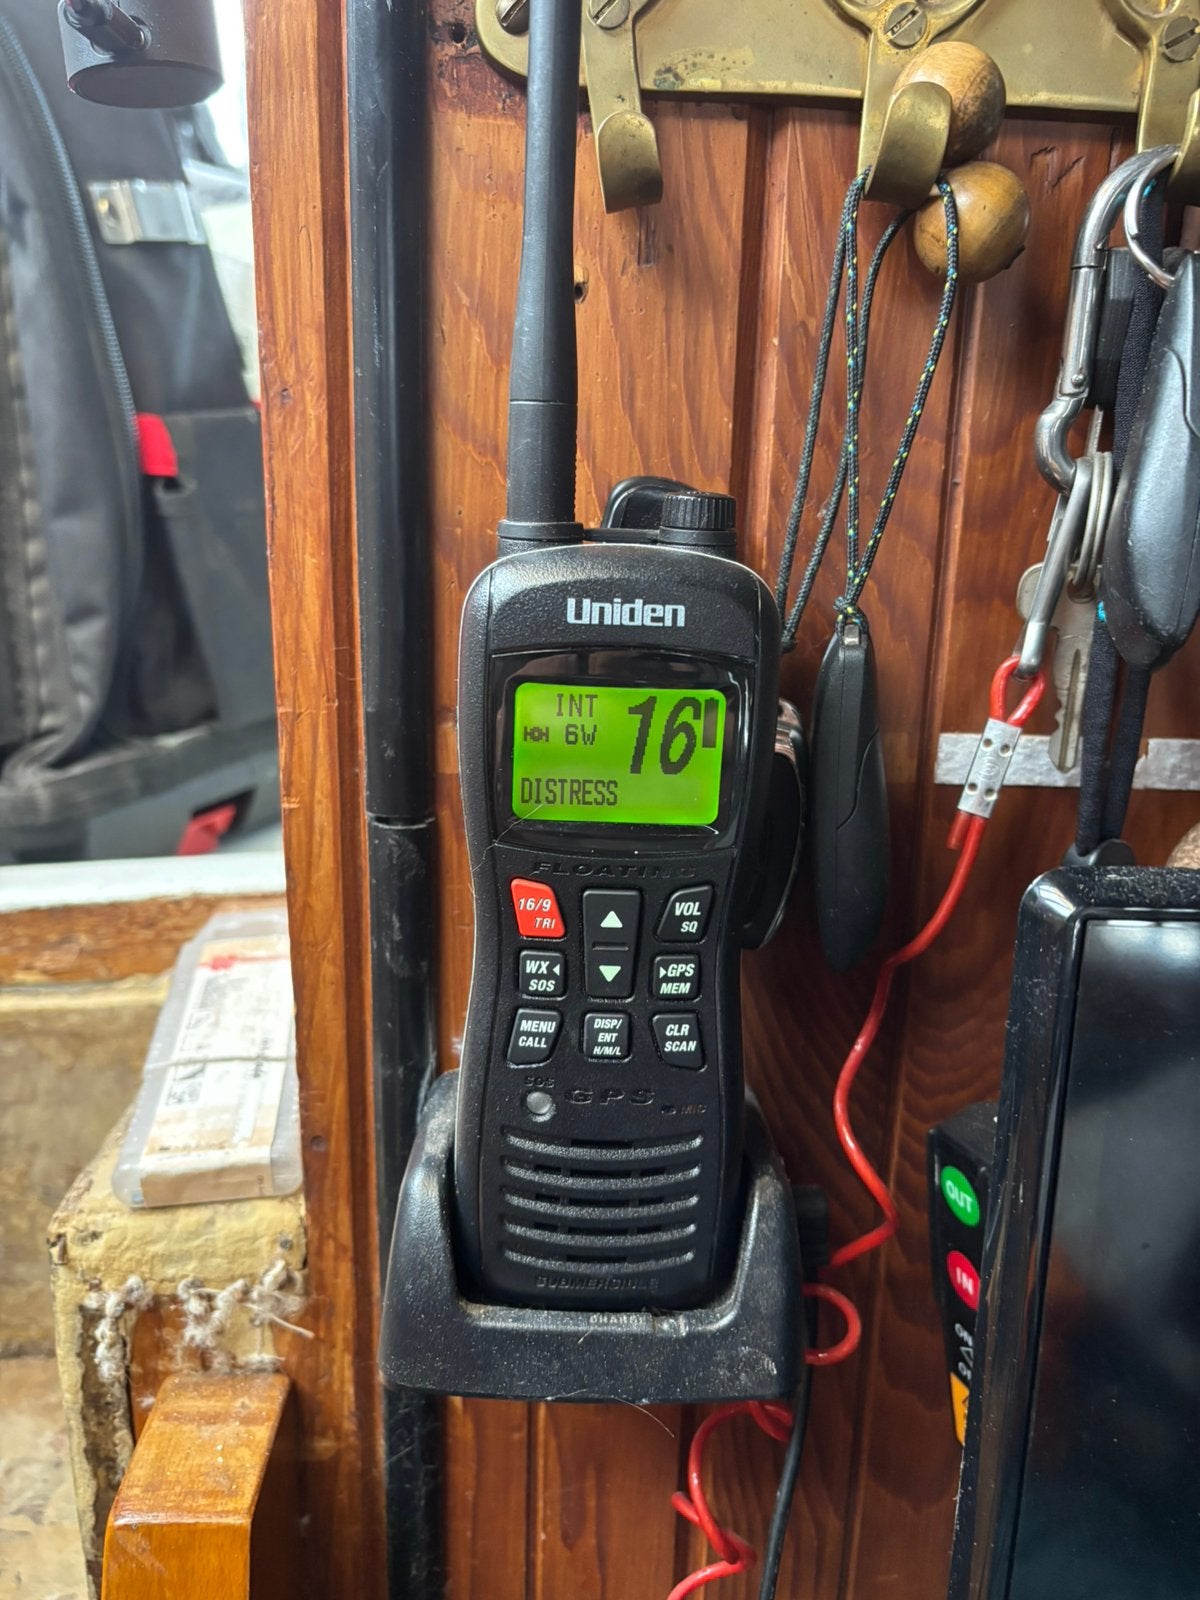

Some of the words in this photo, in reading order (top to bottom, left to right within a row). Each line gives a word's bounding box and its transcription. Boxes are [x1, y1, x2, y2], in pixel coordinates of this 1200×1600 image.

[567, 598, 686, 627] Uniden
[556, 693, 599, 718] INT
[564, 723, 598, 746] 6W
[627, 696, 702, 776] 16
[520, 777, 618, 806] DISTRESS
[518, 897, 552, 912] 16/9
[674, 902, 701, 916] VOL
[534, 917, 556, 929] TRI
[680, 921, 698, 933] SQ
[525, 959, 549, 975] WX
[667, 963, 696, 978] GPS
[528, 979, 556, 992] SOS
[660, 982, 691, 994] MEM
[520, 1019, 556, 1033] MENU
[593, 1018, 622, 1030] DISP/
[665, 1024, 690, 1036] CLR
[518, 1036, 547, 1048] CALL
[597, 1033, 618, 1043] ENT
[593, 1046, 622, 1056] H/M/L
[664, 1040, 697, 1051] SCAN
[524, 1075, 556, 1089] SOS
[565, 1087, 656, 1106] GPS
[681, 1103, 707, 1115] MIC
[945, 1180, 973, 1213] OUT
[956, 1267, 974, 1295] IN
